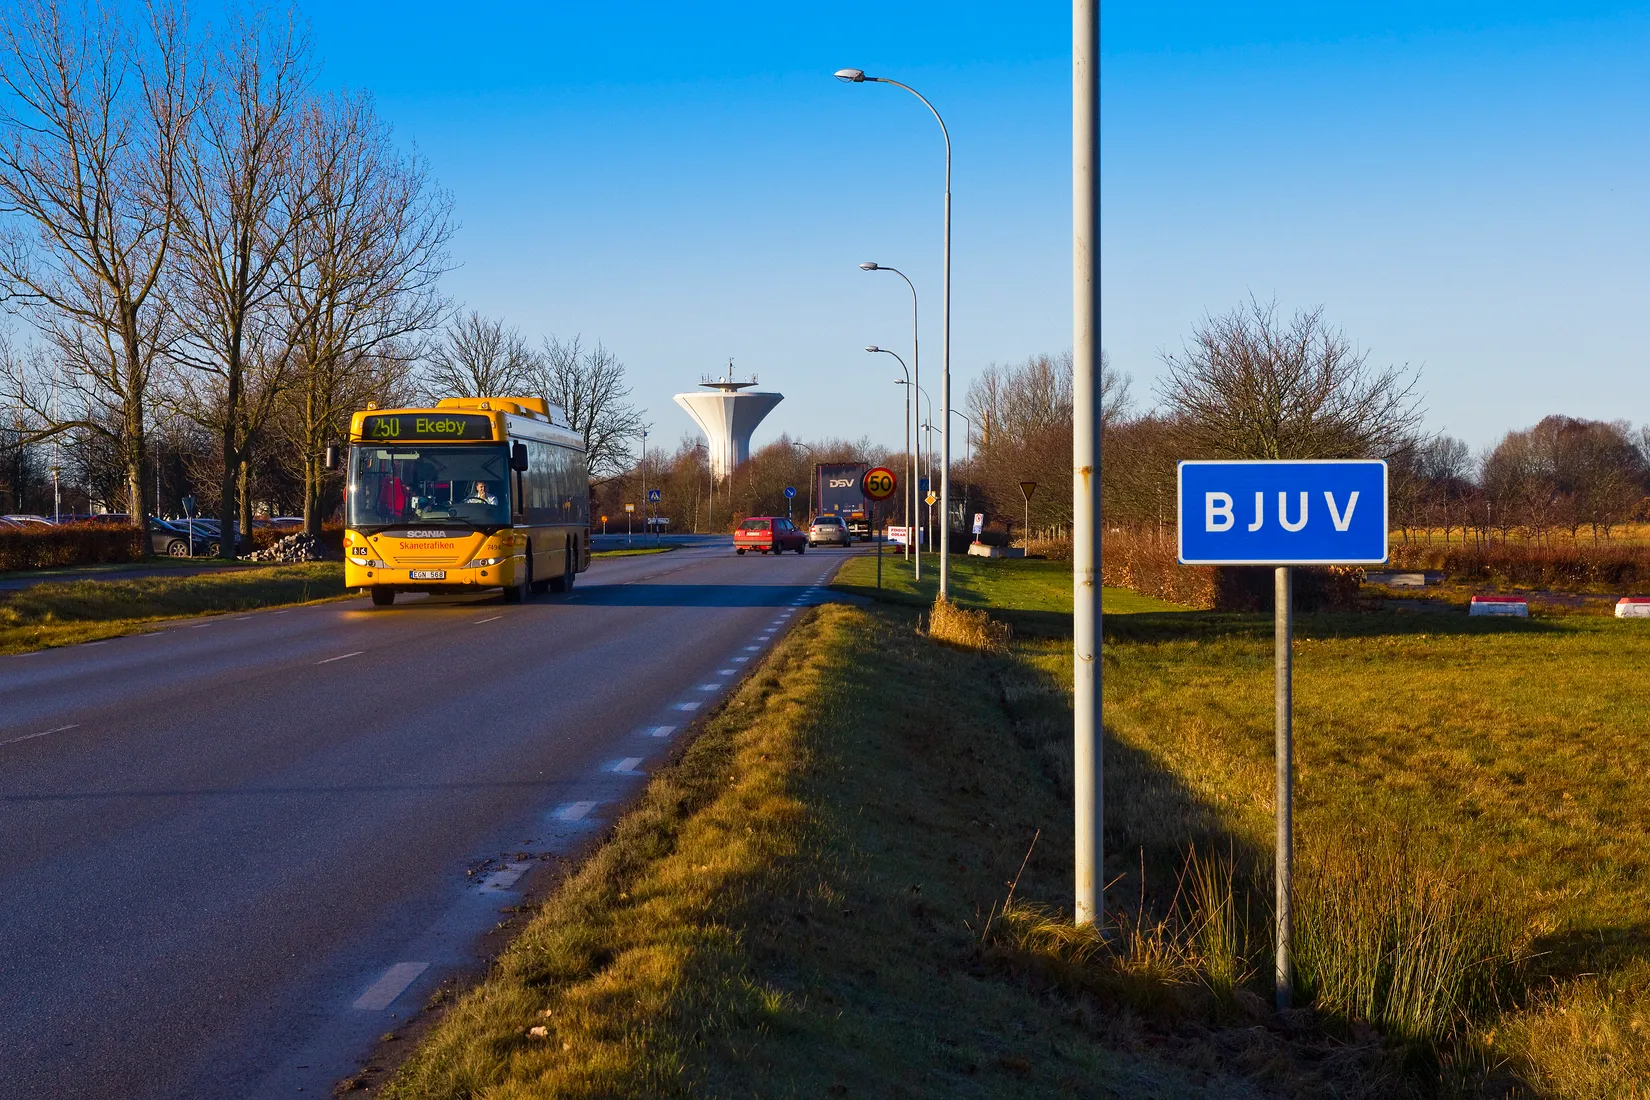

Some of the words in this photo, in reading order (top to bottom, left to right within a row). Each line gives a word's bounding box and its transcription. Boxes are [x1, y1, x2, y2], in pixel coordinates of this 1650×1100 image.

[371, 418, 400, 437] 250
[416, 418, 466, 436] Ekeby
[829, 478, 855, 488] DSV
[870, 475, 892, 492] 50
[1205, 491, 1360, 532] BJUV
[406, 530, 447, 538] SCANIA
[399, 541, 455, 550] Skånetrafiken
